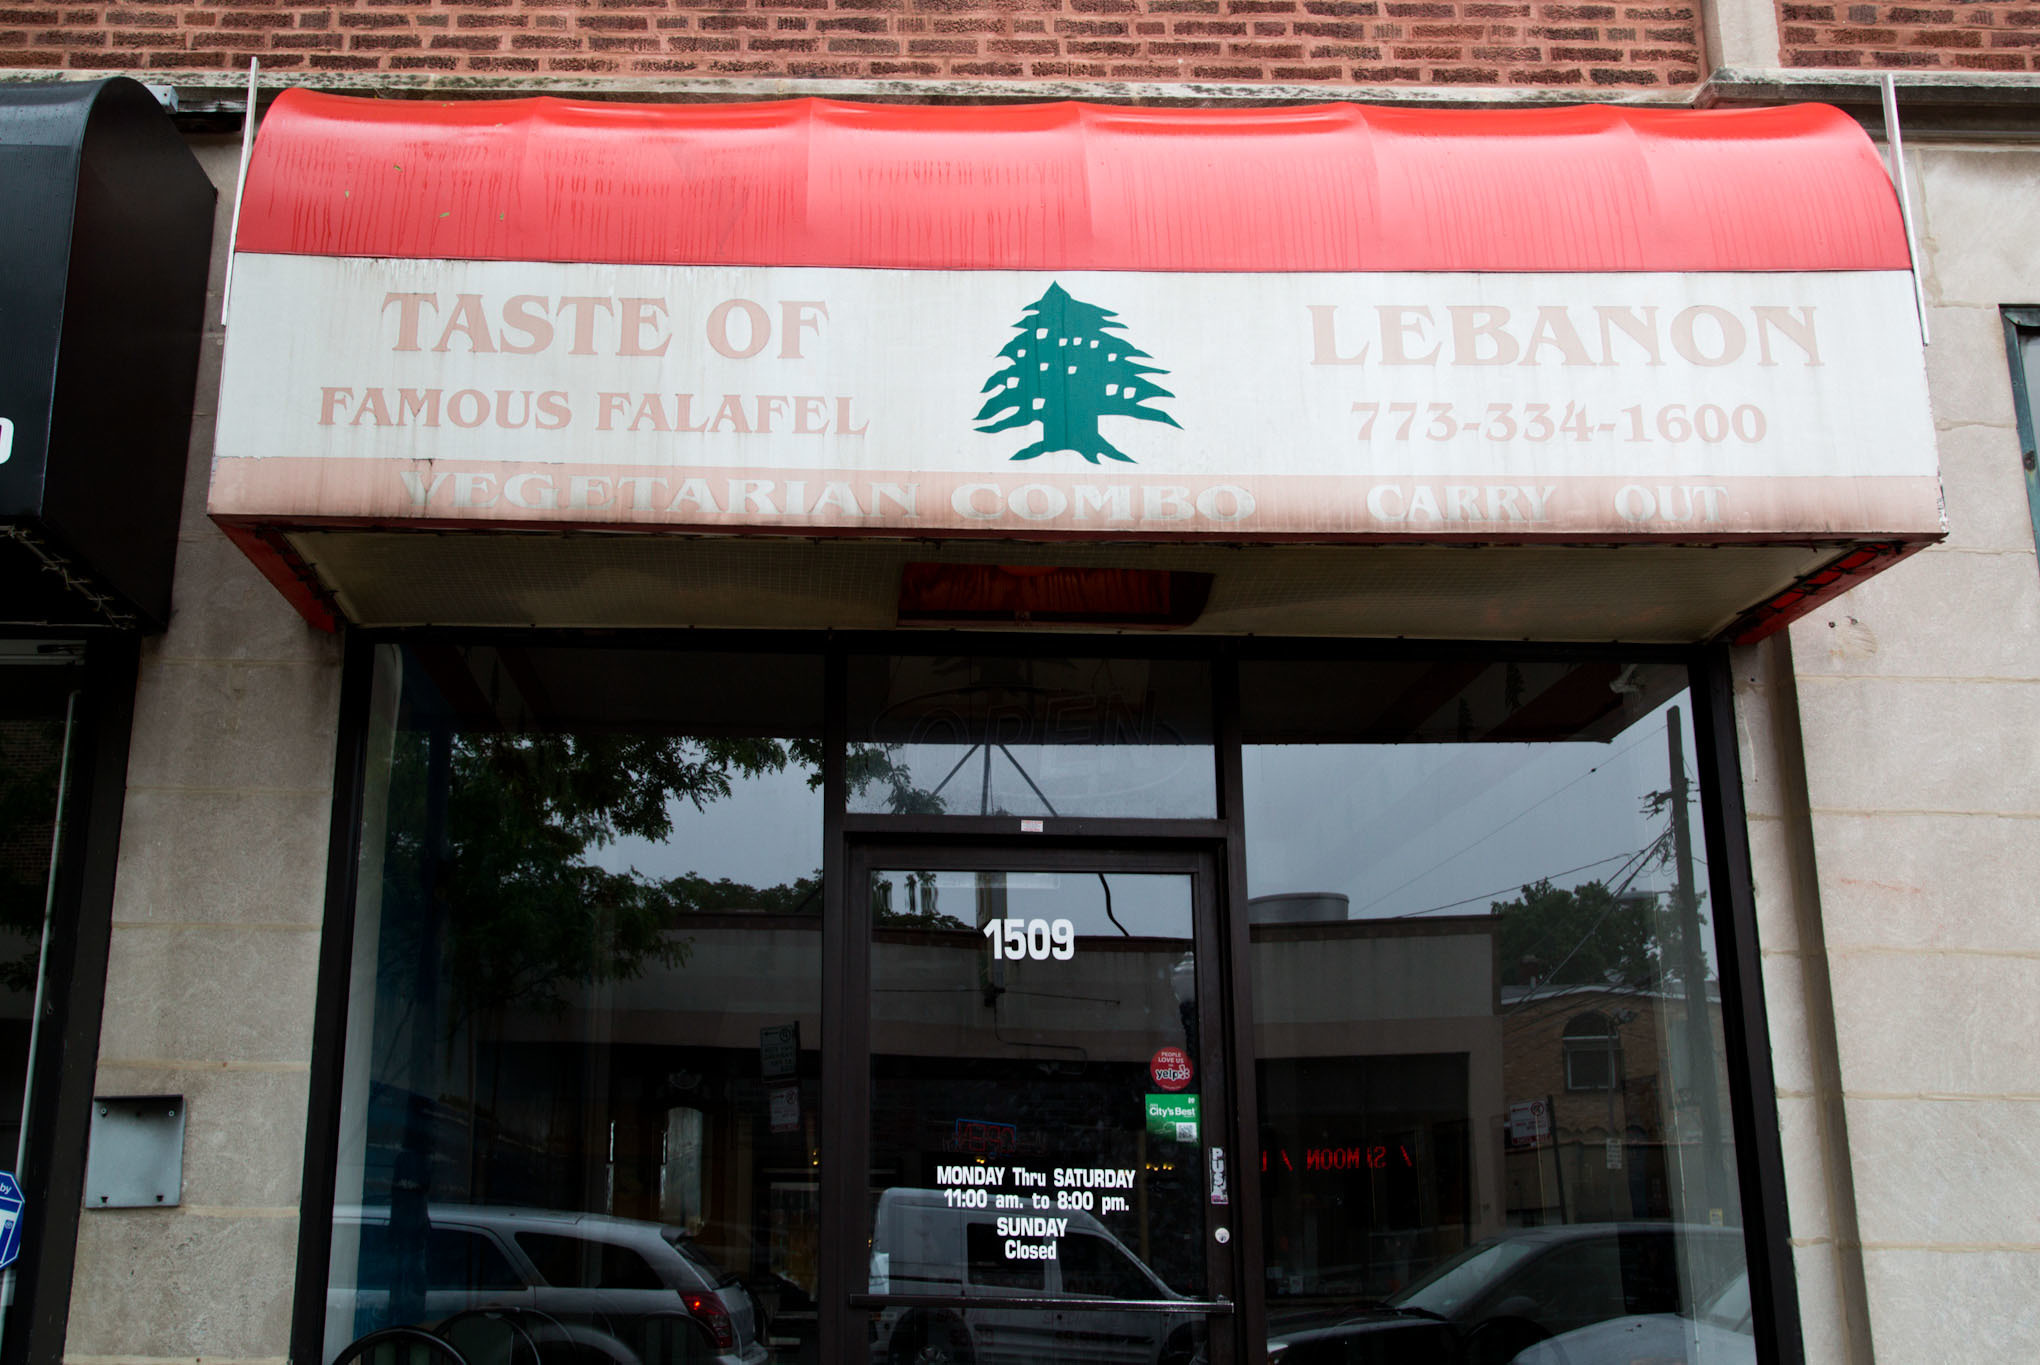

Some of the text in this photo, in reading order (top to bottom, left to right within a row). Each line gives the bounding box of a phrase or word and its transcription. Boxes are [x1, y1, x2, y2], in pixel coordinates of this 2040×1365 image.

[381, 292, 830, 360] TASTE OF
[1305, 304, 1825, 368] LEBANON
[318, 386, 870, 437] FAMOUS FALAFEL
[1350, 400, 1768, 443] 773-334-1600
[400, 469, 1730, 523] VEGETARIAN COMBO CARRY OUT
[983, 918, 1075, 960] 1509
[1155, 1069, 1180, 1082] yelp
[1149, 1107, 1196, 1117] City's Best
[936, 1165, 1136, 1189] MONDAY Thru SATURDAY
[943, 1189, 1130, 1216] 11:00 am. to 8:00 pm.
[996, 1217, 1068, 1238] SUNDAY
[1004, 1239, 1057, 1261] Closed
